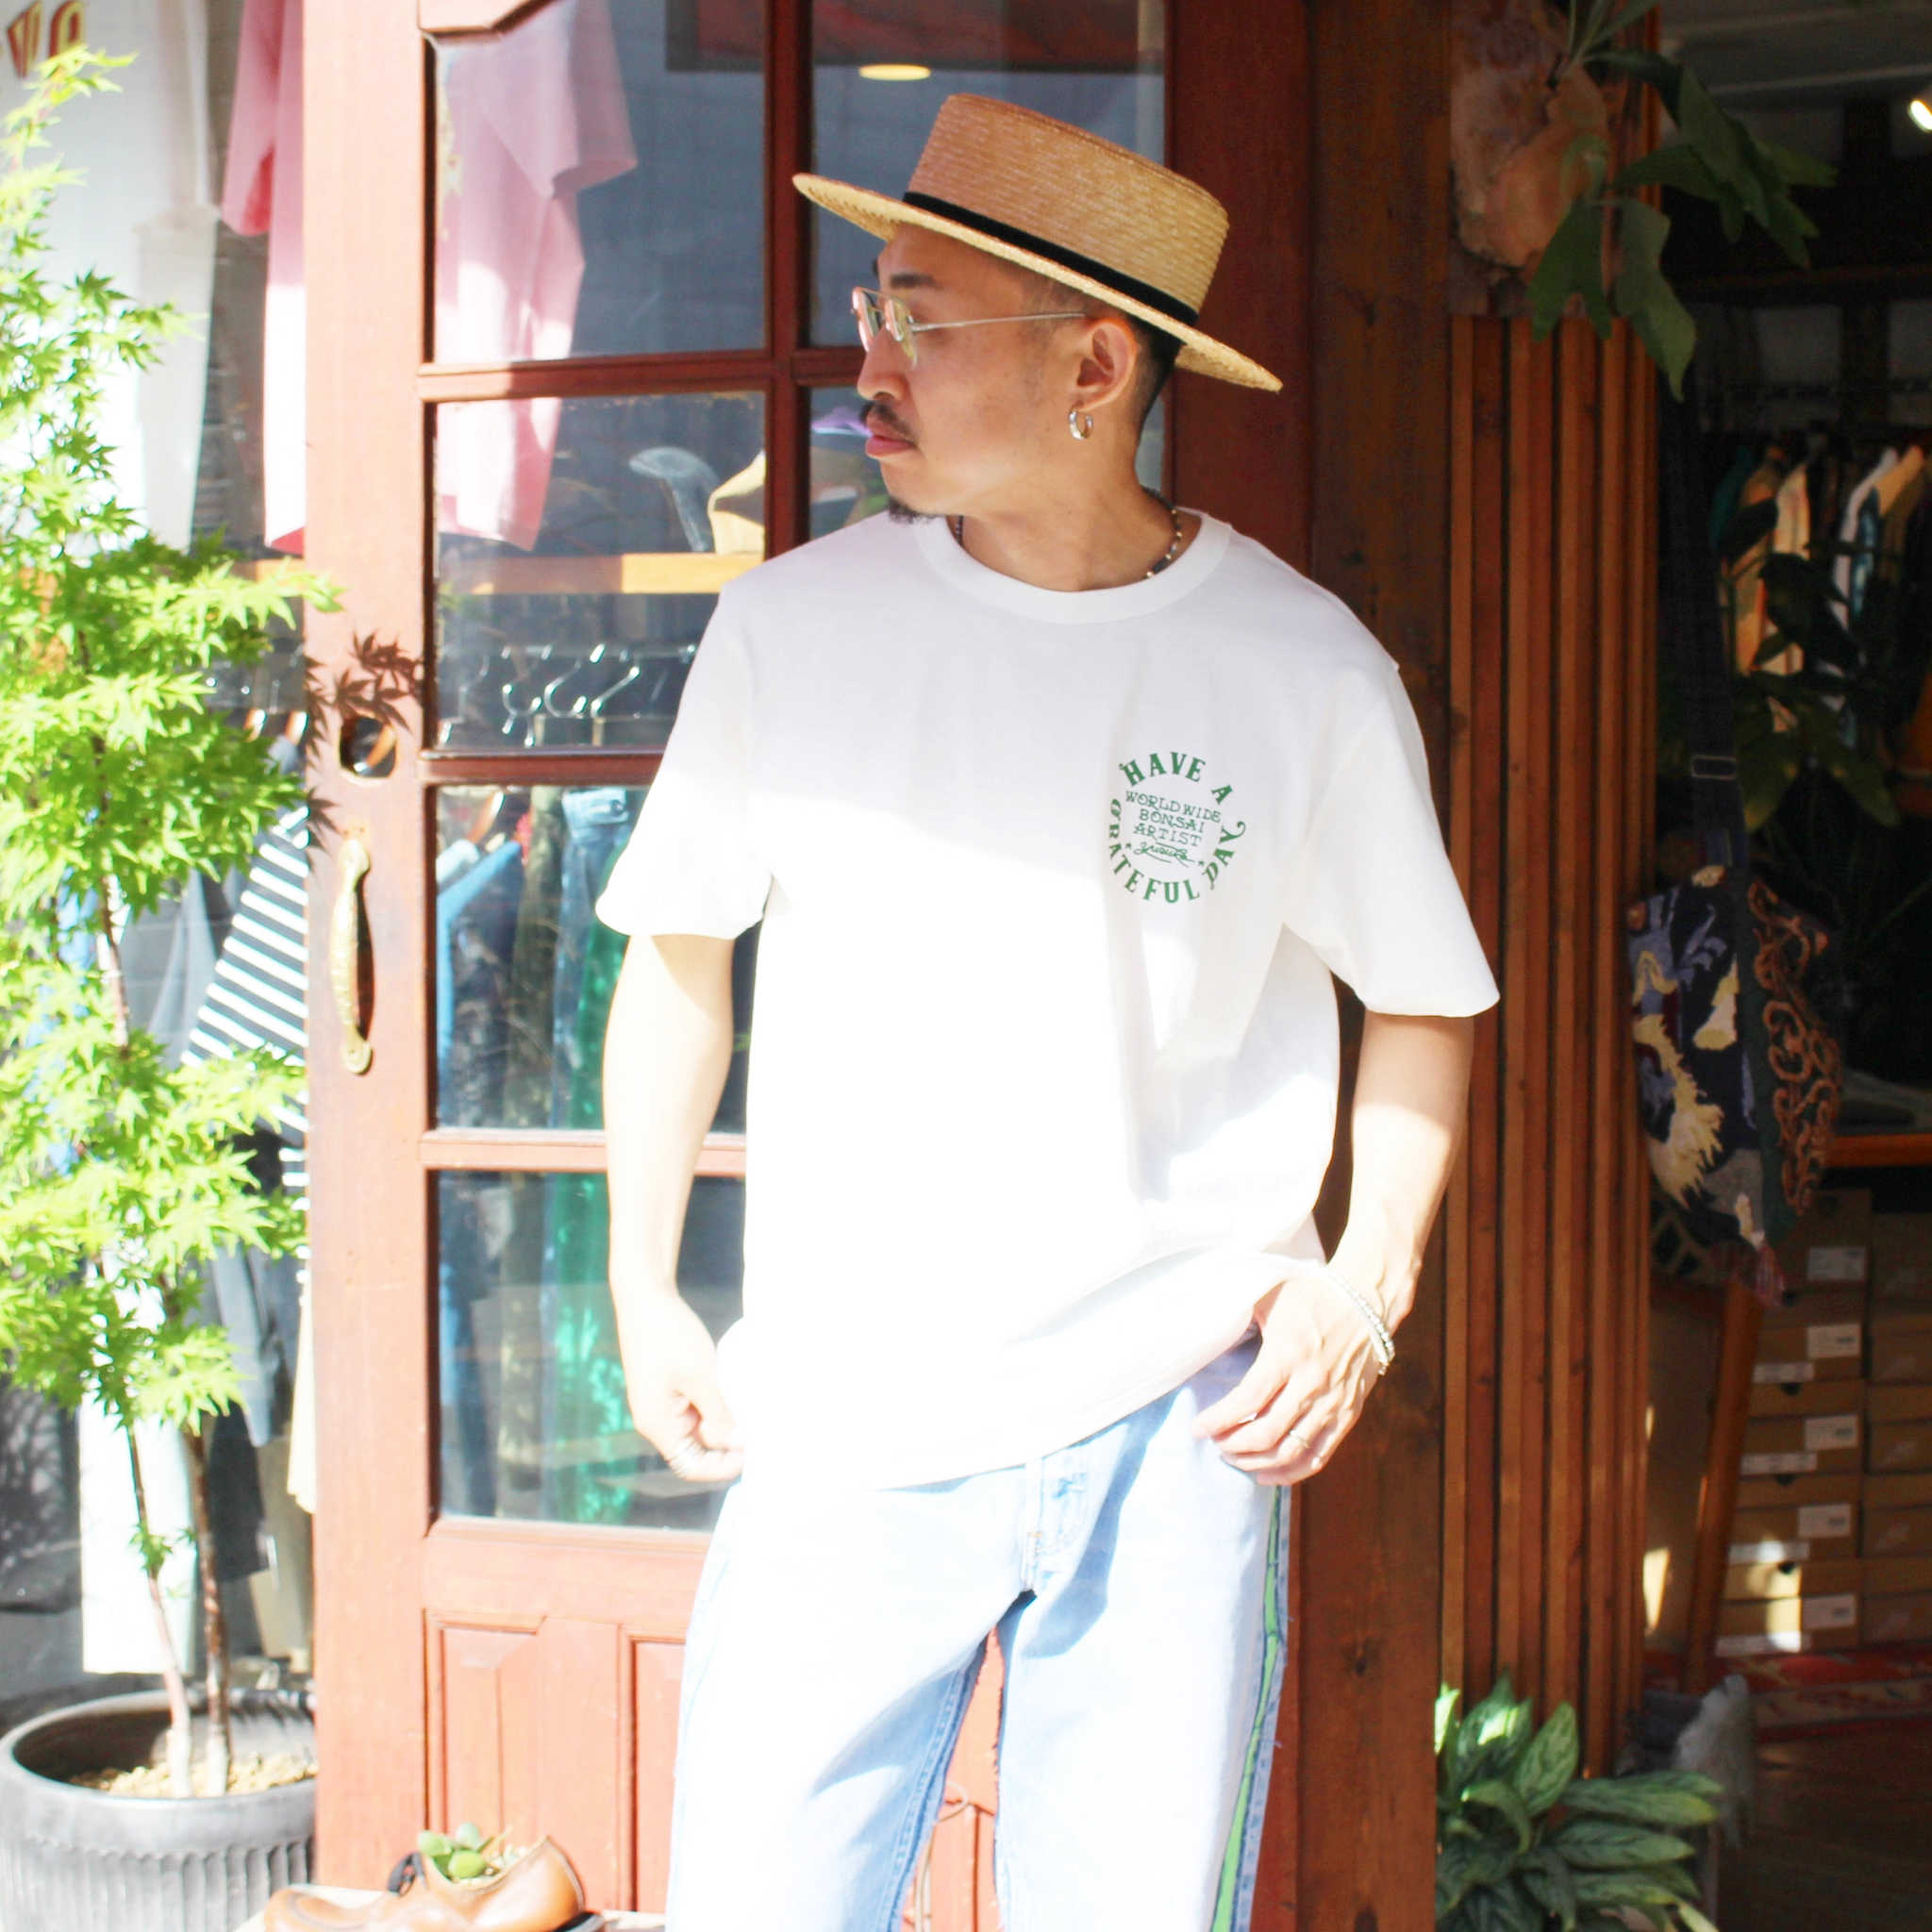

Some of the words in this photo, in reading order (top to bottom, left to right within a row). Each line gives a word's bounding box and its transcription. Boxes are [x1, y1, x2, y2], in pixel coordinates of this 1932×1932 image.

[1118, 751, 1207, 788] HAVE
[1210, 784, 1234, 806] A
[1139, 808, 1205, 834] BONSAI
[1133, 822, 1203, 847] ARTIST
[1202, 820, 1246, 891] DAY
